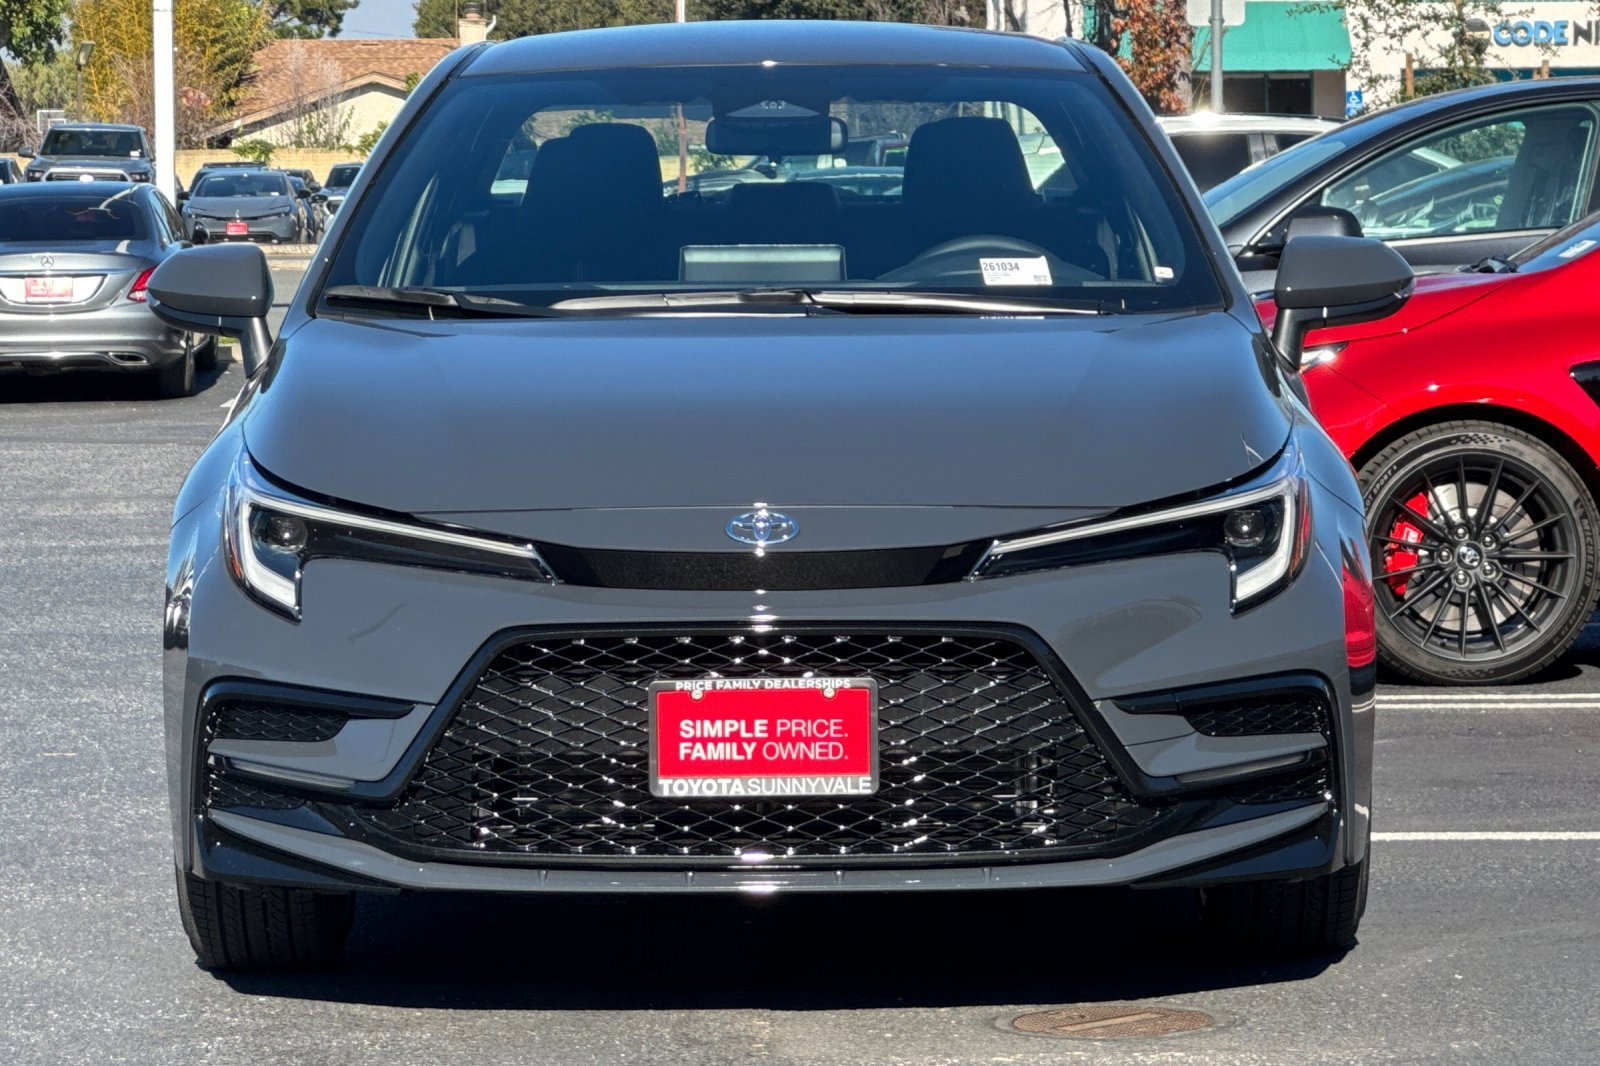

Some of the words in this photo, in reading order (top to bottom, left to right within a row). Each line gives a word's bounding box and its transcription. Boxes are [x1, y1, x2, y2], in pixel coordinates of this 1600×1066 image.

[1494, 20, 1569, 47] CODE
[983, 262, 1020, 271] 261034
[1373, 470, 1392, 494] SPORT
[1581, 519, 1594, 586] MICHELIN
[675, 681, 713, 691] PRICE
[716, 680, 761, 690] FAMILY
[764, 679, 851, 689] DEALERSHIPS
[679, 719, 769, 738] SIMPLE
[776, 719, 848, 738] PRICE.
[679, 742, 757, 760] FAMILY
[762, 741, 848, 760] OWNED.
